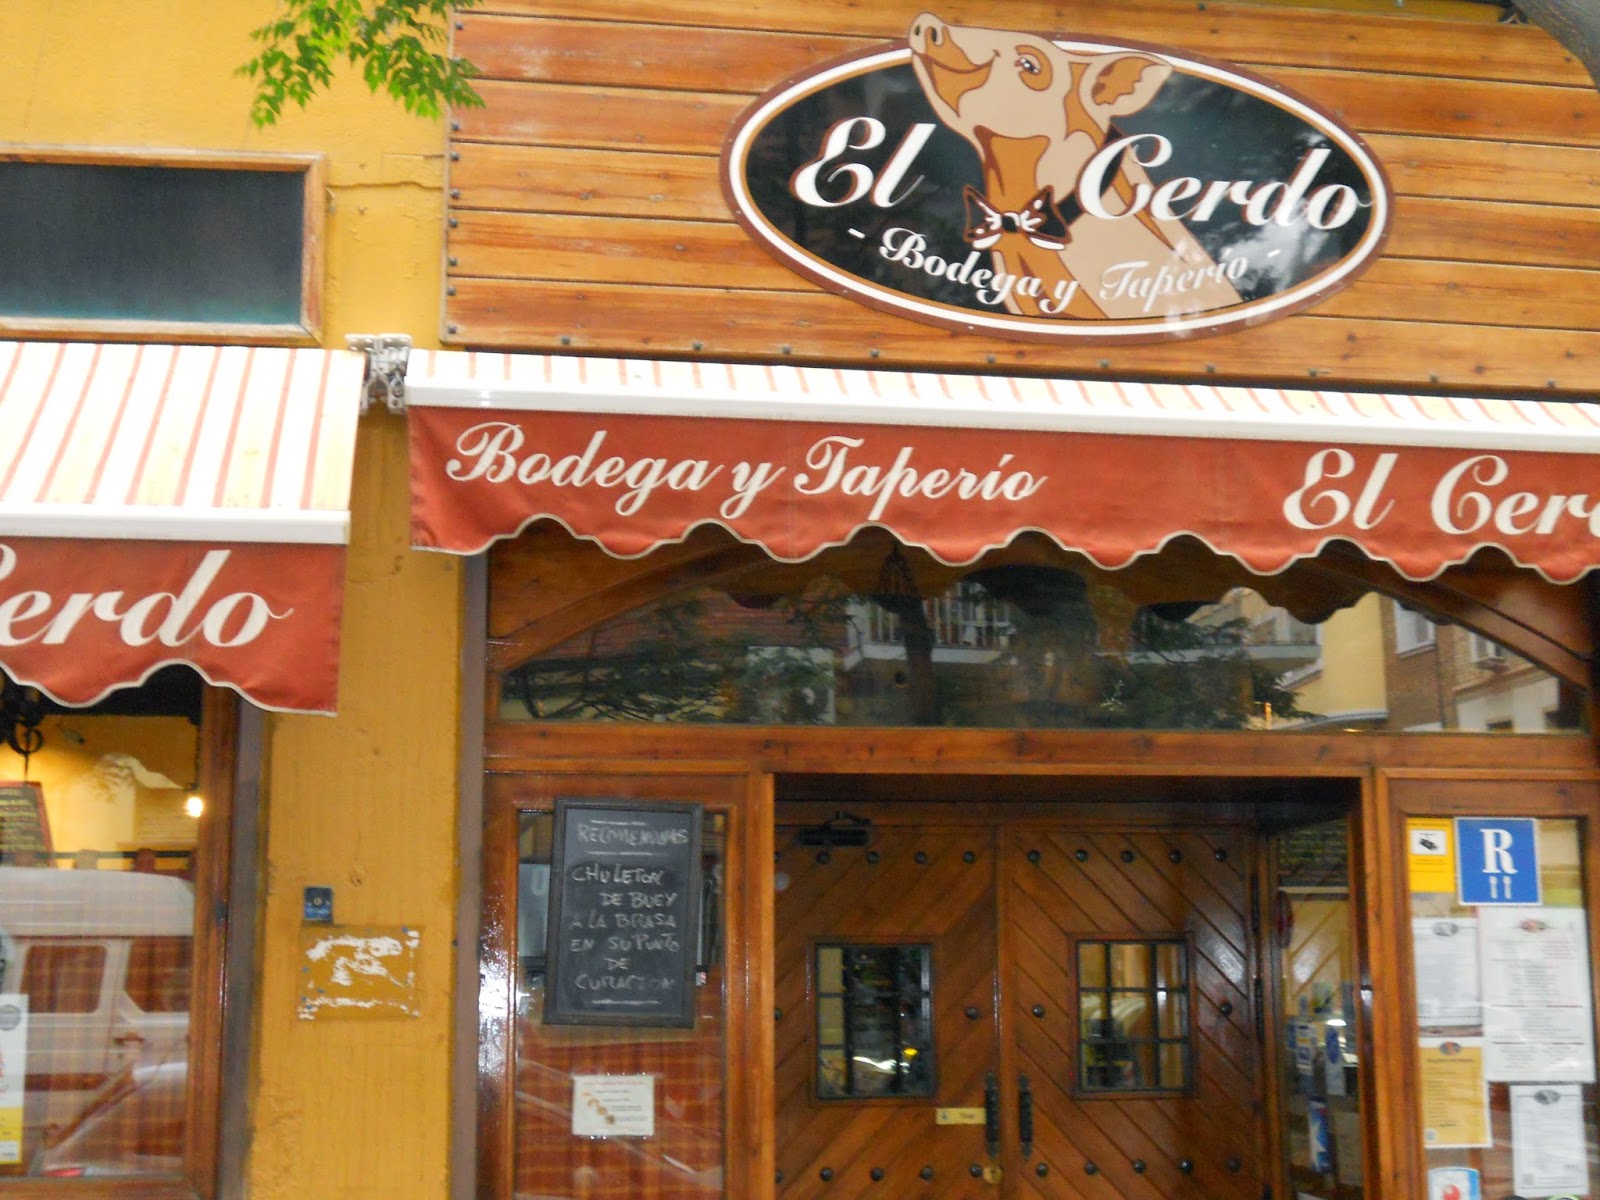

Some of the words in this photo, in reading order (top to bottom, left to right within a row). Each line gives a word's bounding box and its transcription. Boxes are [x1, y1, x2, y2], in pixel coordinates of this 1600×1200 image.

[789, 116, 937, 208] El
[1077, 133, 1373, 230] Cerdo
[879, 227, 1043, 305] Bodega
[1039, 280, 1079, 314] y
[446, 421, 725, 517] Bodega
[719, 461, 786, 519] y
[793, 435, 1048, 521] Taperío
[1283, 448, 1398, 529] El
[1430, 455, 1600, 539] Cer
[1480, 828, 1519, 874] R
[588, 909, 607, 928] LA
[614, 913, 677, 928] BRASA
[628, 891, 678, 909] BUEY
[607, 936, 632, 951] SU
